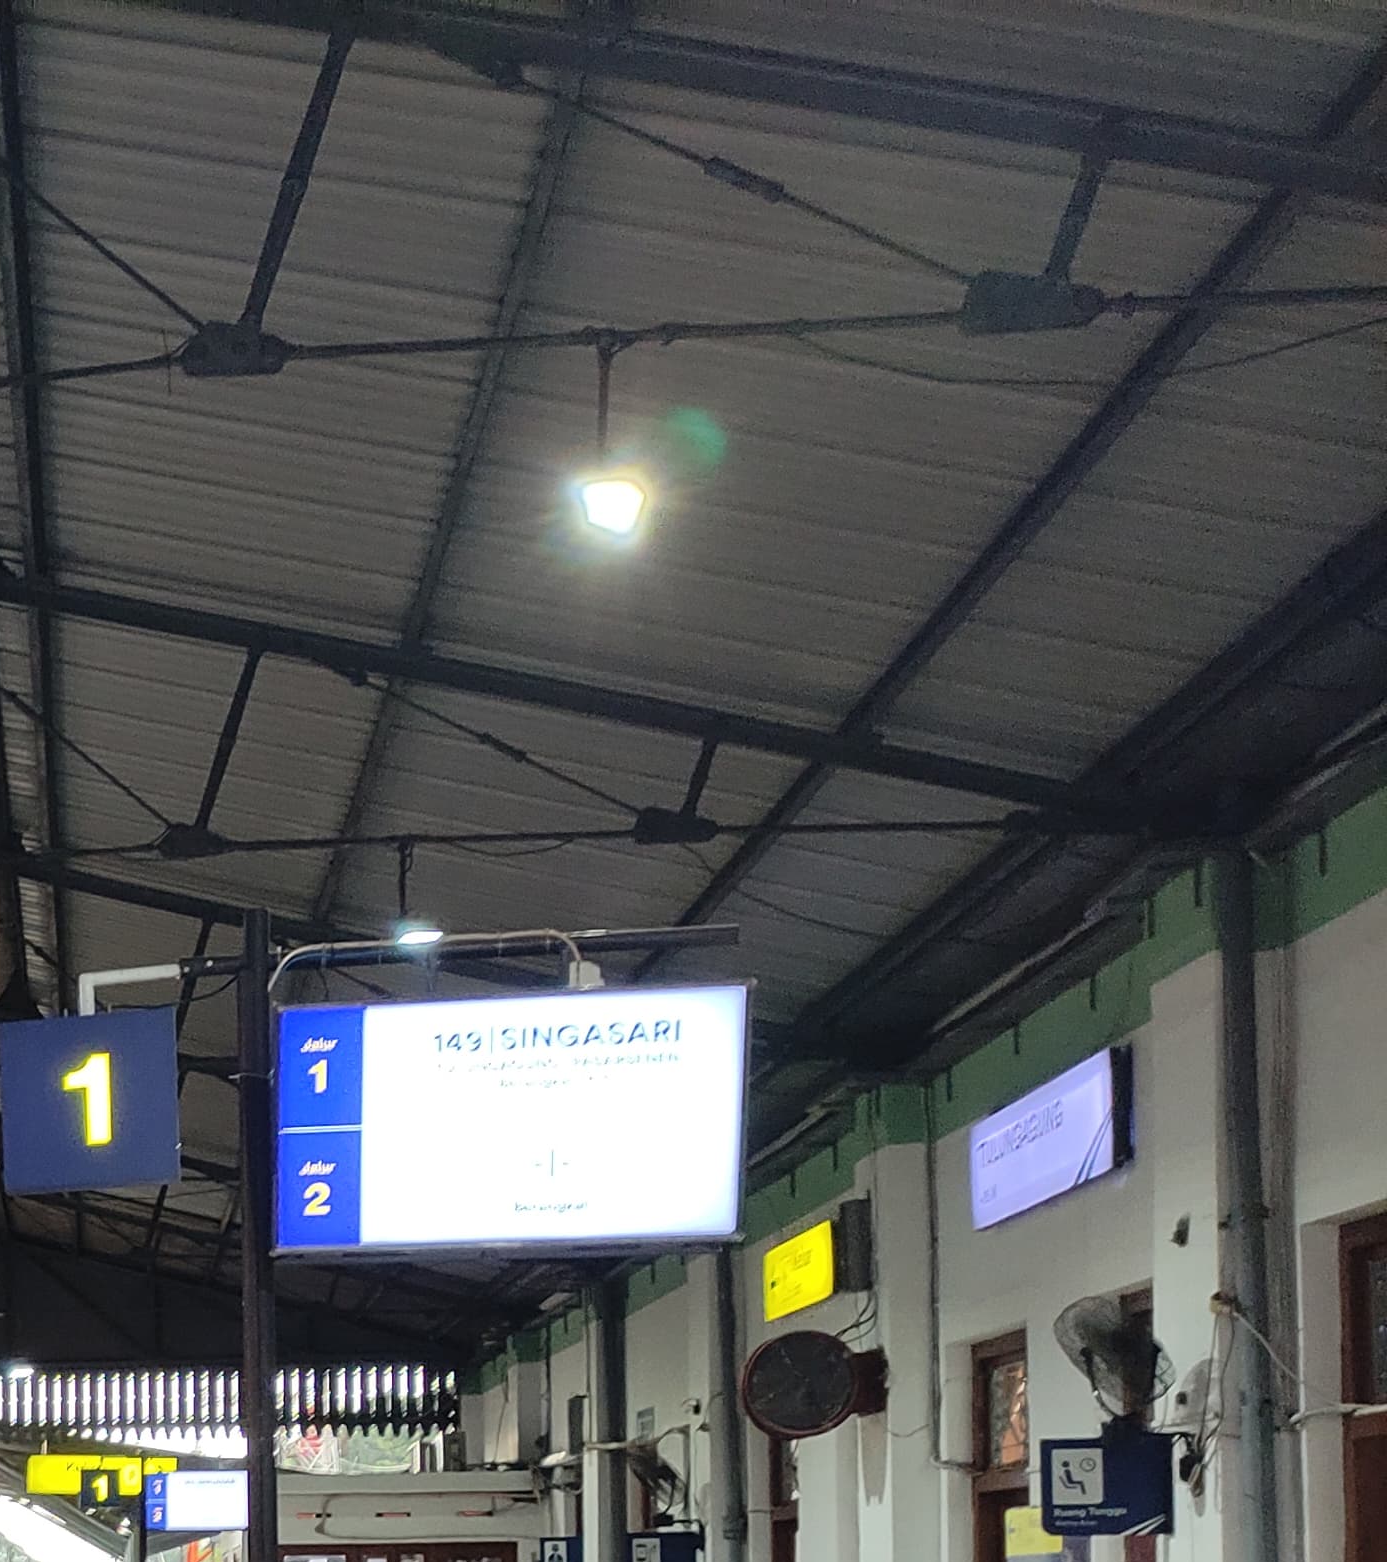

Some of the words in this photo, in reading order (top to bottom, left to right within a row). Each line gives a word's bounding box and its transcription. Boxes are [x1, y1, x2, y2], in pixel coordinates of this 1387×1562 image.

[434, 1030, 483, 1053] 149
[501, 1018, 682, 1051] SINGASARI
[307, 1059, 329, 1094] 1
[62, 1052, 114, 1148] 1
[303, 1181, 332, 1217] 2
[91, 1473, 109, 1503] 1
